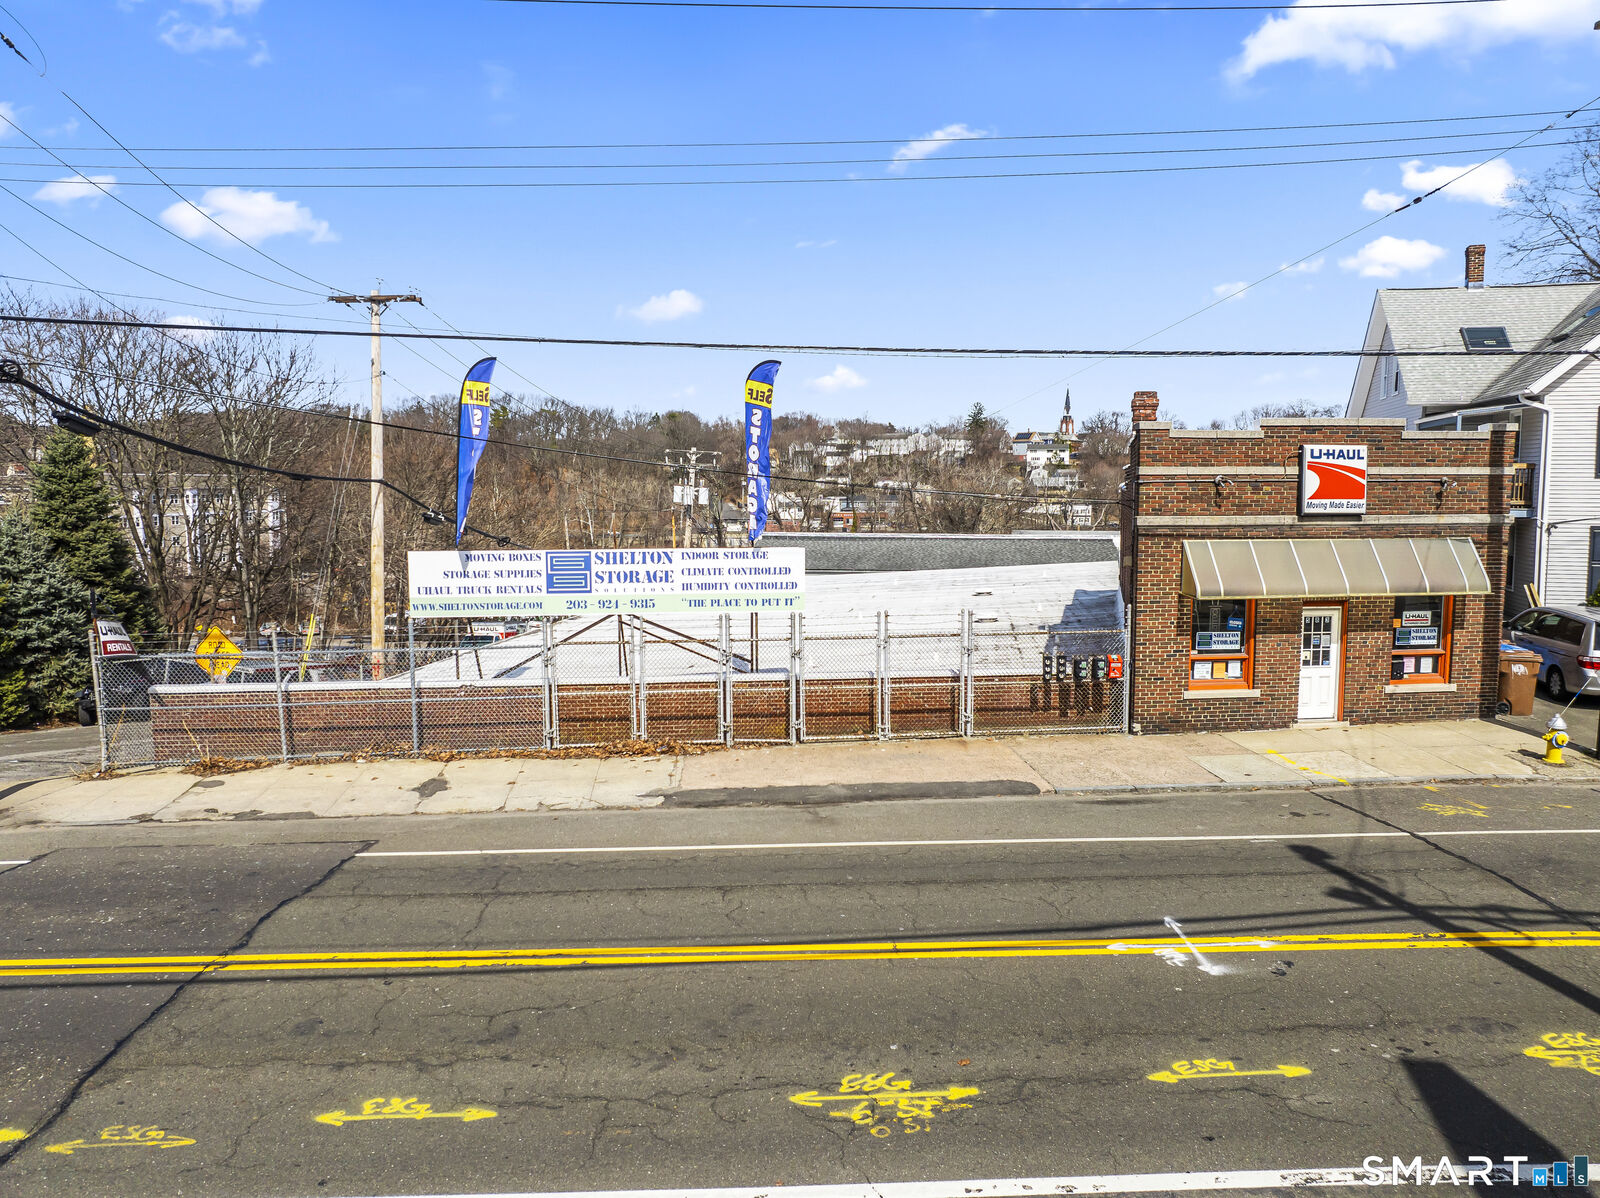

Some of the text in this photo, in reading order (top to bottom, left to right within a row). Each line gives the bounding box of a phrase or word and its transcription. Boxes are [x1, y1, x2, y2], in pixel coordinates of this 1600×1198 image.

[1310, 448, 1364, 460] U-HAUL
[1306, 501, 1364, 510] Moving Made Easier
[465, 552, 542, 563] MOVING BOXES
[594, 550, 674, 566] SHELTON
[681, 551, 769, 561] INDOOR STORAGE
[442, 569, 543, 580] STORAGE SUPPLIES
[594, 569, 674, 584] STORAGE
[681, 567, 792, 577] CLIMATE CONTROLLED
[417, 584, 543, 596] UHAUL TRUCK RENTALS
[681, 582, 798, 592] HUMIDITY CONTROLLED
[412, 601, 543, 612] WWW.SHELTONSTORAGE.COM
[566, 600, 588, 610] 203
[598, 599, 619, 609] 924
[630, 599, 656, 609] 9315
[710, 598, 742, 608] PLACE
[745, 598, 758, 607] TO
[761, 598, 782, 607] PUT
[106, 643, 132, 652] RENTALS
